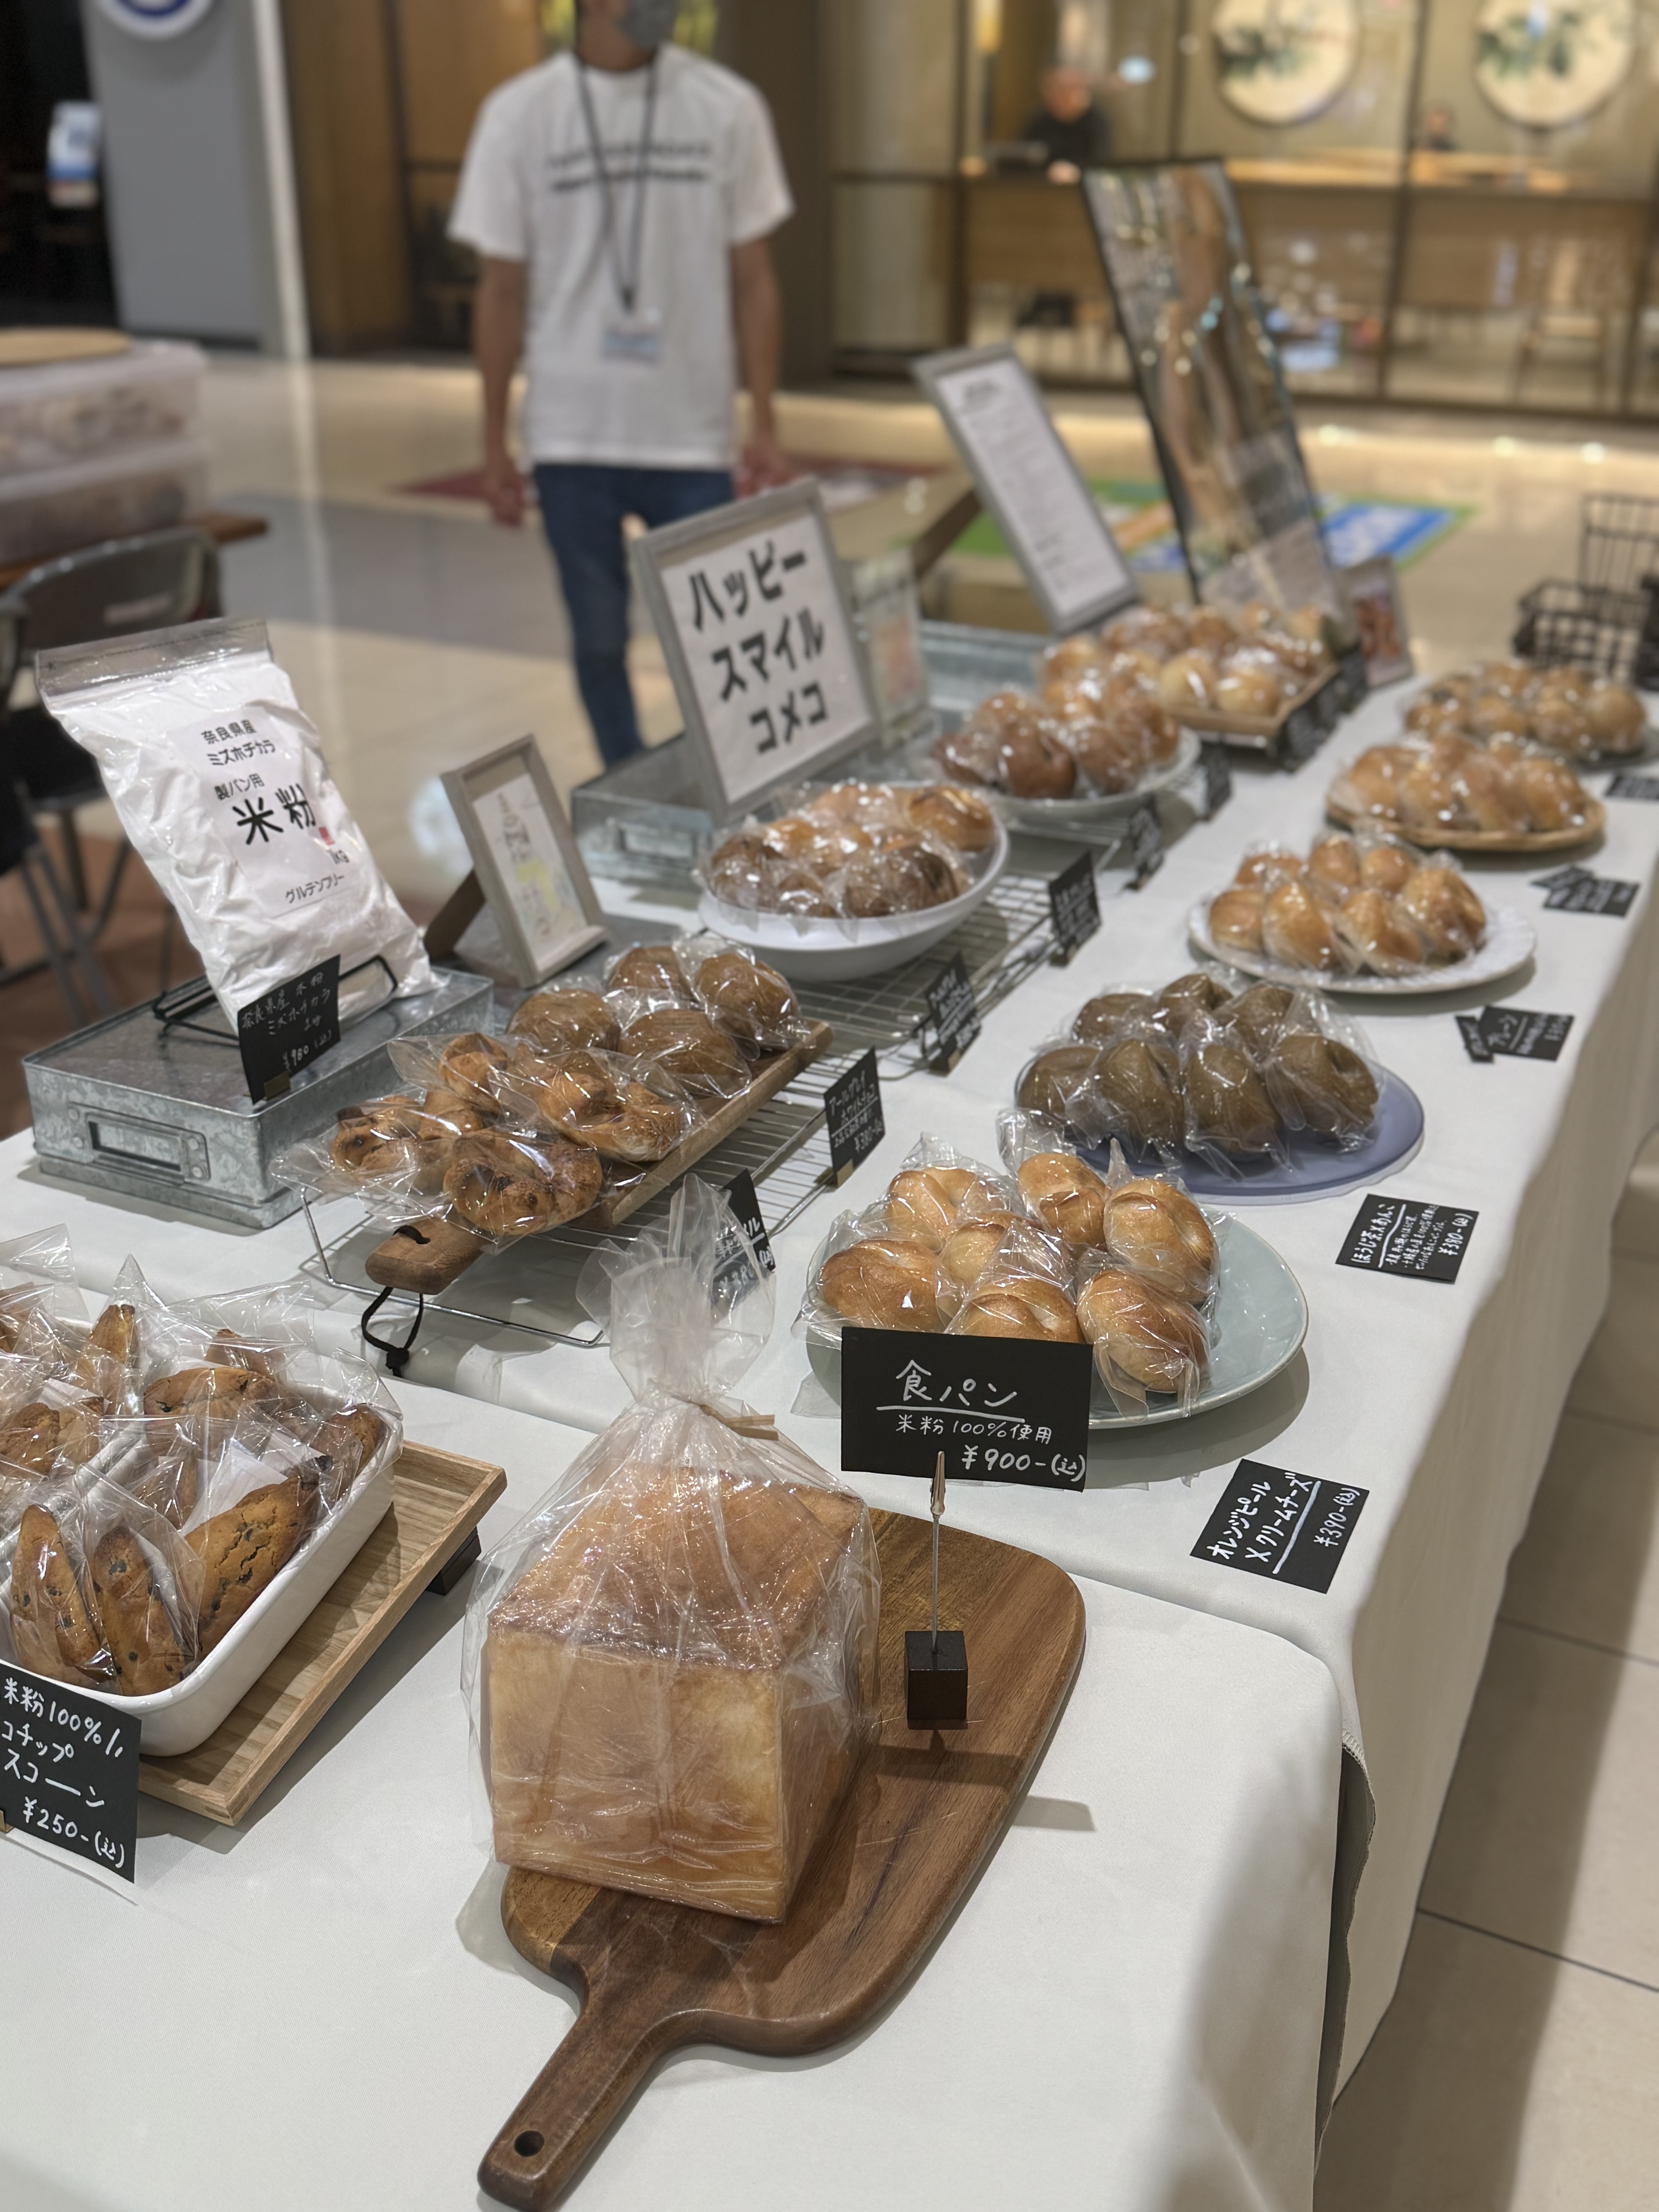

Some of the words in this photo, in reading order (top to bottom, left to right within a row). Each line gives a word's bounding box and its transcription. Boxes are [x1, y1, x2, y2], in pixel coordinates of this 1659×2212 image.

[690, 539, 808, 632] ハッピー
[711, 606, 824, 701] スマイル
[201, 720, 256, 744] 奈良県産
[750, 680, 828, 754] コメコ
[207, 740, 275, 766] ミズホチカラ
[215, 773, 265, 800] 製パン用
[232, 783, 316, 845] 米粉
[285, 873, 345, 903] グルテンフリー
[896, 1359, 1018, 1407] 食パン
[1206, 1481, 1271, 1560] オレンジピール
[4, 1748, 105, 1808] スコーン
